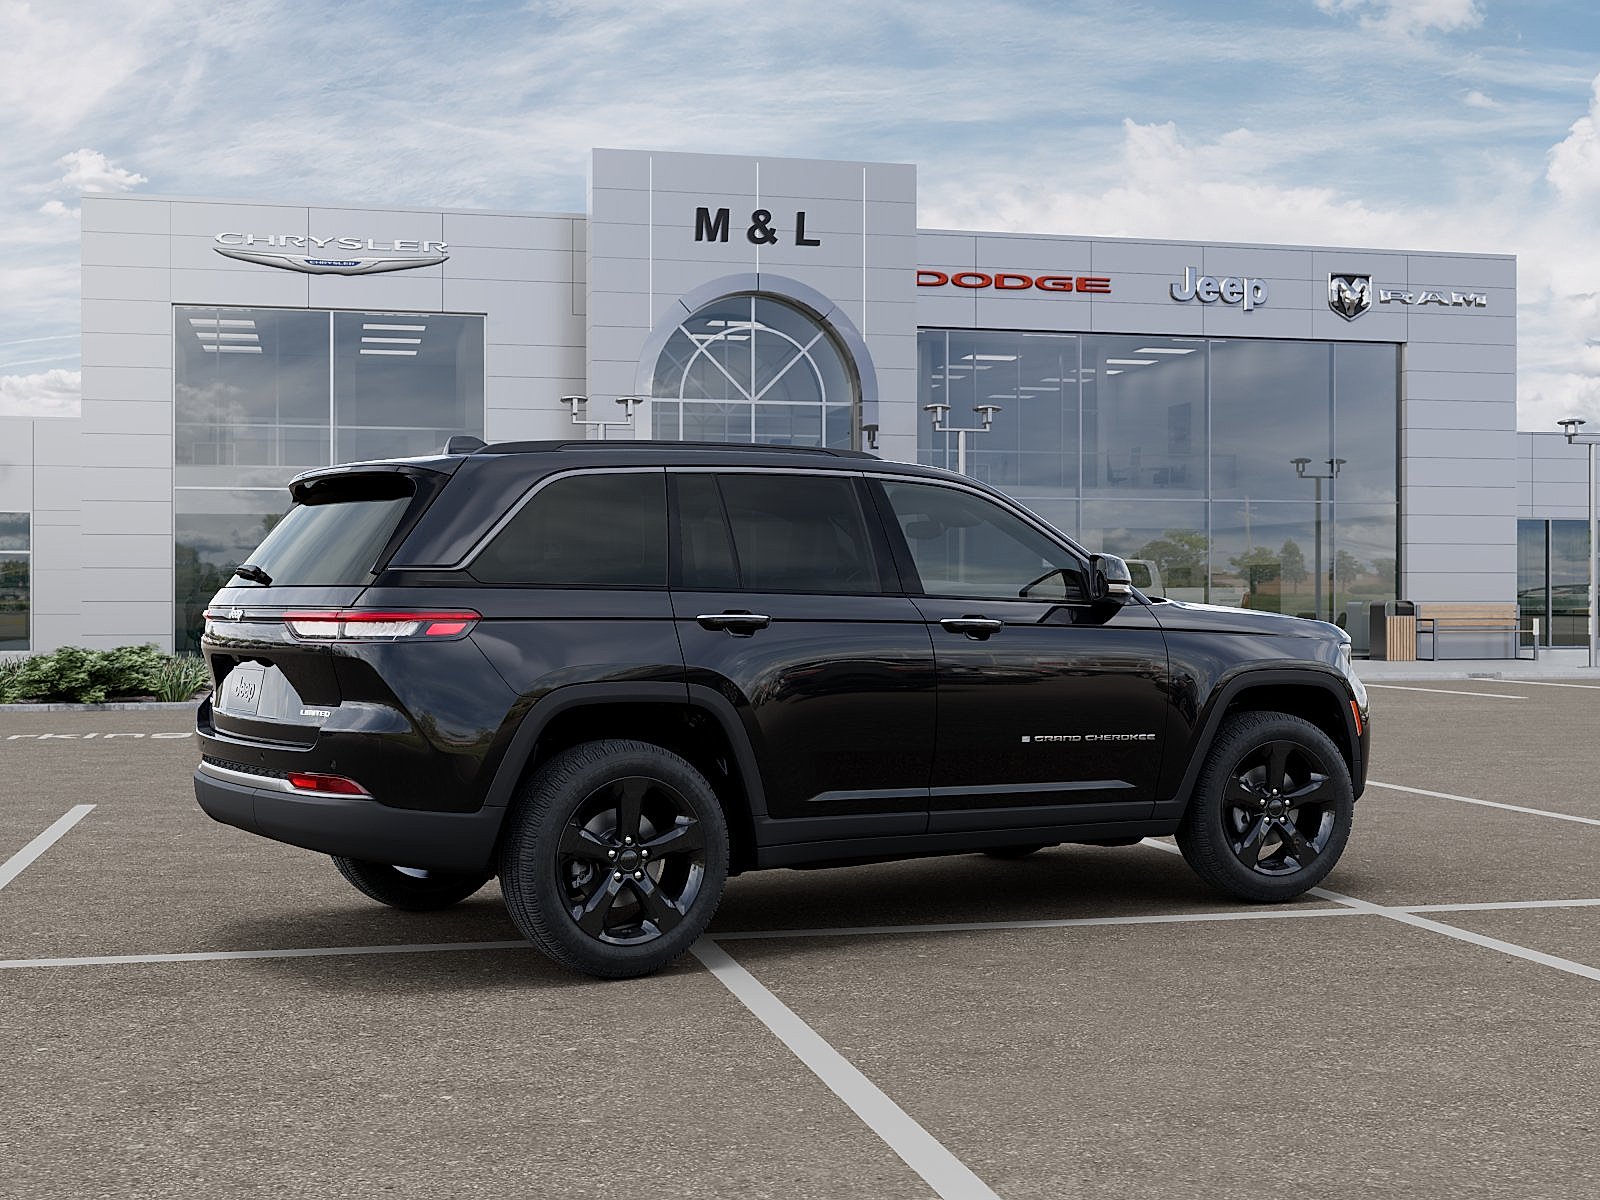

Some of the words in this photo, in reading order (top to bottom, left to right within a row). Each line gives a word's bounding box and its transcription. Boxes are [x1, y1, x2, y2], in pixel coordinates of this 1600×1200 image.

[694, 206, 730, 243] M
[746, 208, 779, 246] &
[795, 211, 821, 247] L
[214, 232, 449, 254] CHRYSLER
[916, 270, 1112, 294] DODGE
[1170, 265, 1269, 312] Jeep
[1379, 288, 1488, 308] RAM
[234, 676, 256, 703] Jeep
[300, 709, 332, 718] LIMITED
[1084, 733, 1156, 742] CHEROKEE
